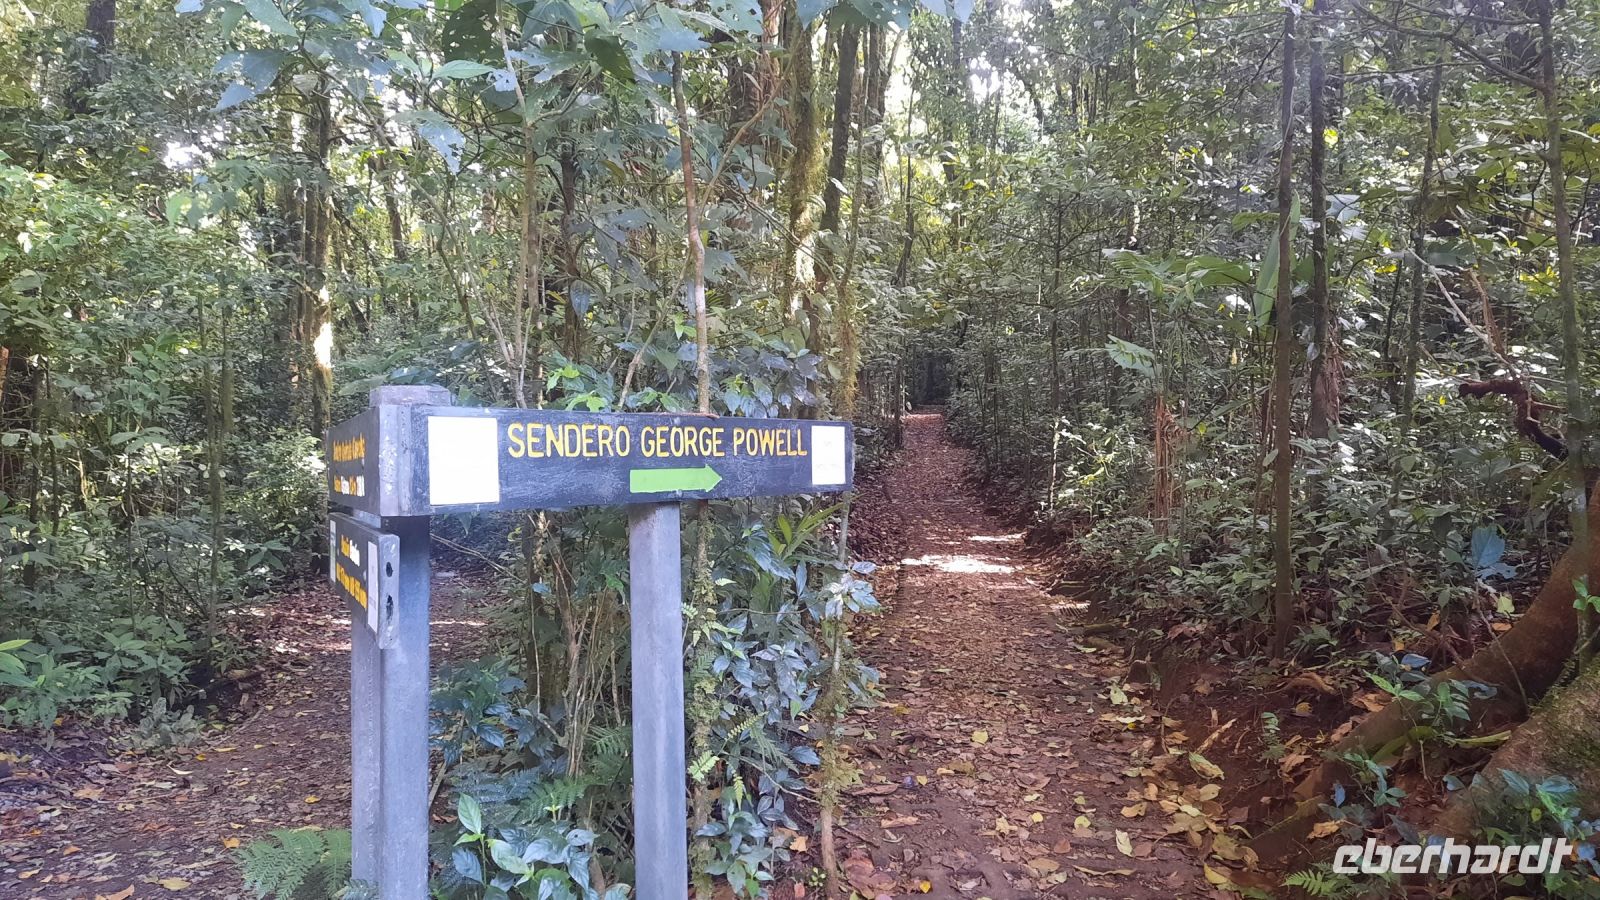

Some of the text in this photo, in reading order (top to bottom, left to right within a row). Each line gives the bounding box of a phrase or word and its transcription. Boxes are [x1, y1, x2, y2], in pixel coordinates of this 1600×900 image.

[507, 423, 808, 458] SENDERO GEORGE POWELL
